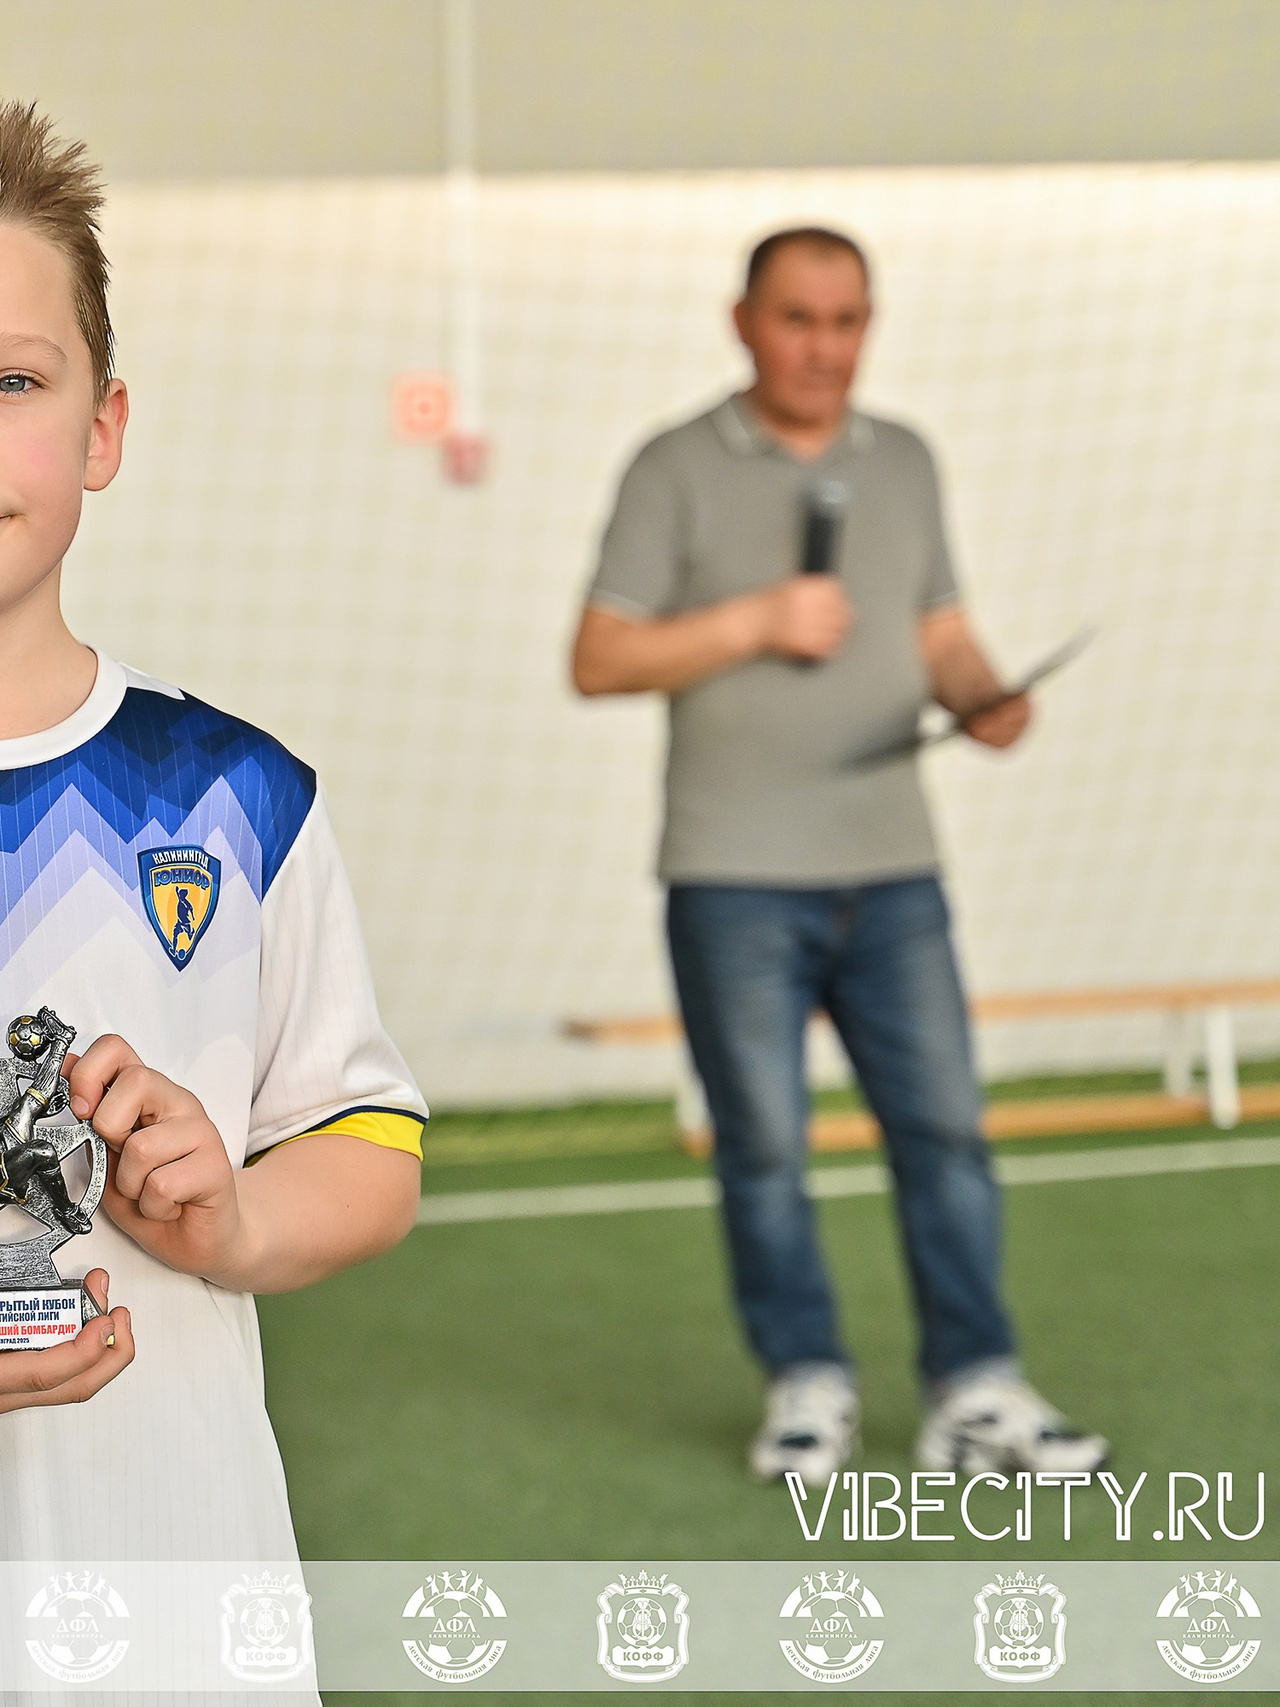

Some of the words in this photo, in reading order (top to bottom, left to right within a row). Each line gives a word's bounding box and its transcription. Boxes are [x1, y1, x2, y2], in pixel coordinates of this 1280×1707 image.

[154, 868, 210, 890] ЮНИОР
[42, 1298, 76, 1310] КУБОК
[37, 1311, 60, 1321] ЛИГИ
[20, 1323, 77, 1335] БОМБАРДИР
